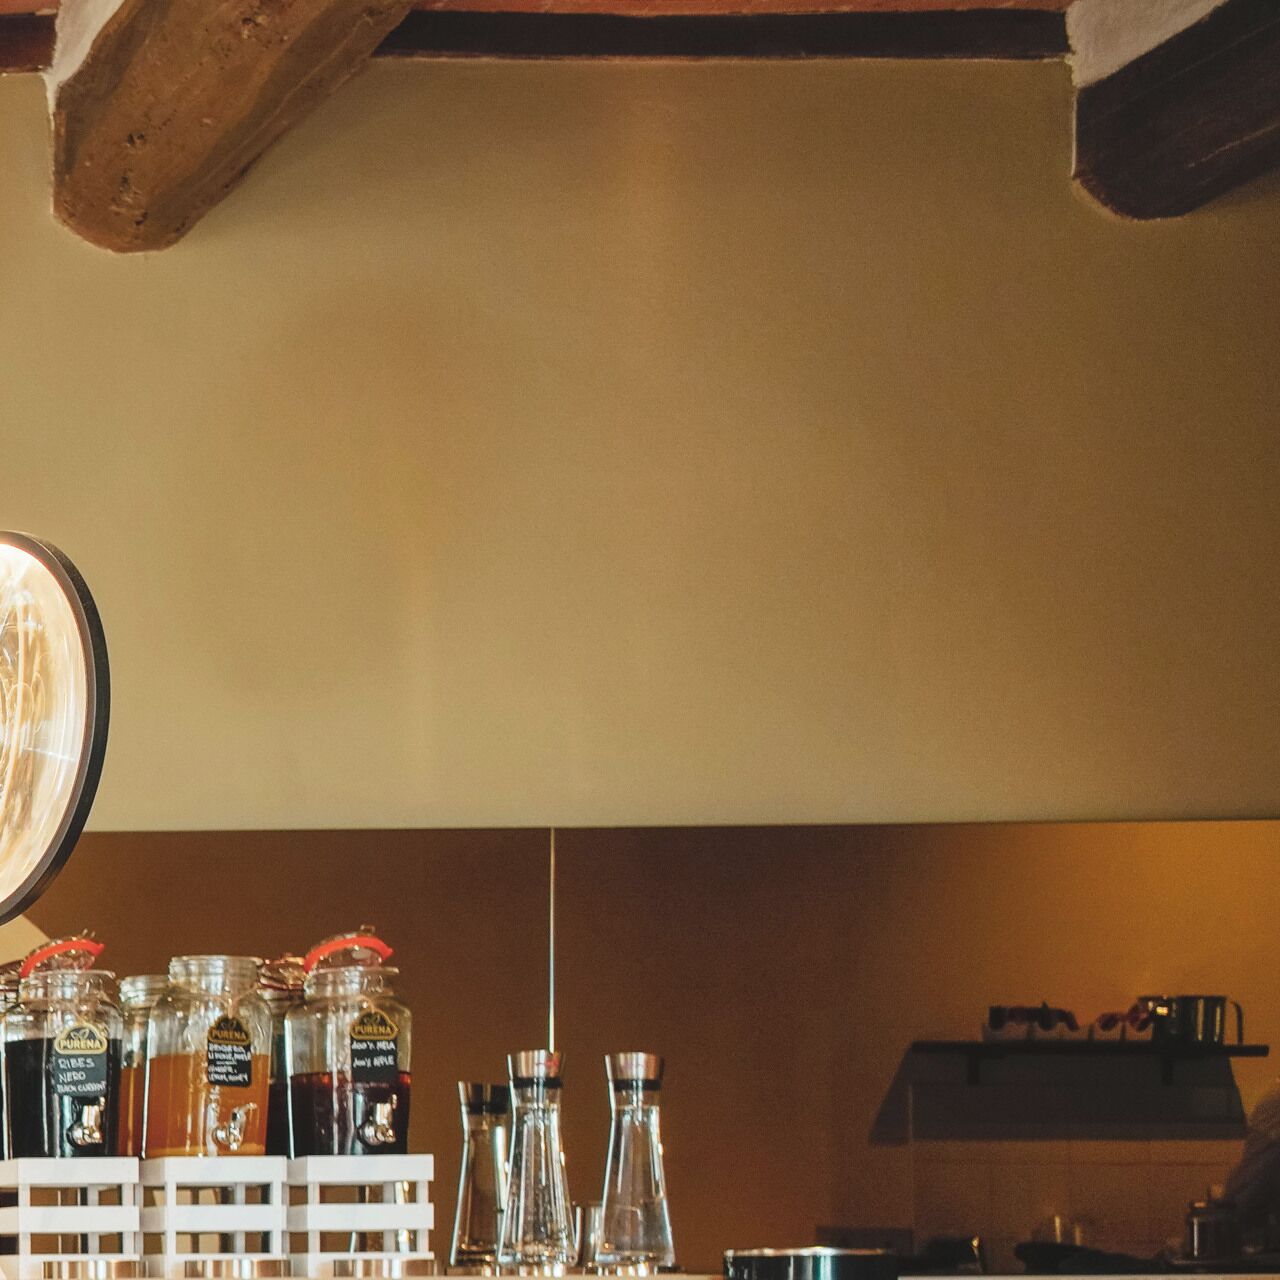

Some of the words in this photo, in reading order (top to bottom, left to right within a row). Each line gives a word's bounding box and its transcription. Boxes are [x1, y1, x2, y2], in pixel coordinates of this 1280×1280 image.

[60, 1040, 101, 1049] PURENA
[58, 1057, 95, 1069] RIBES
[58, 1071, 86, 1083] NERO
